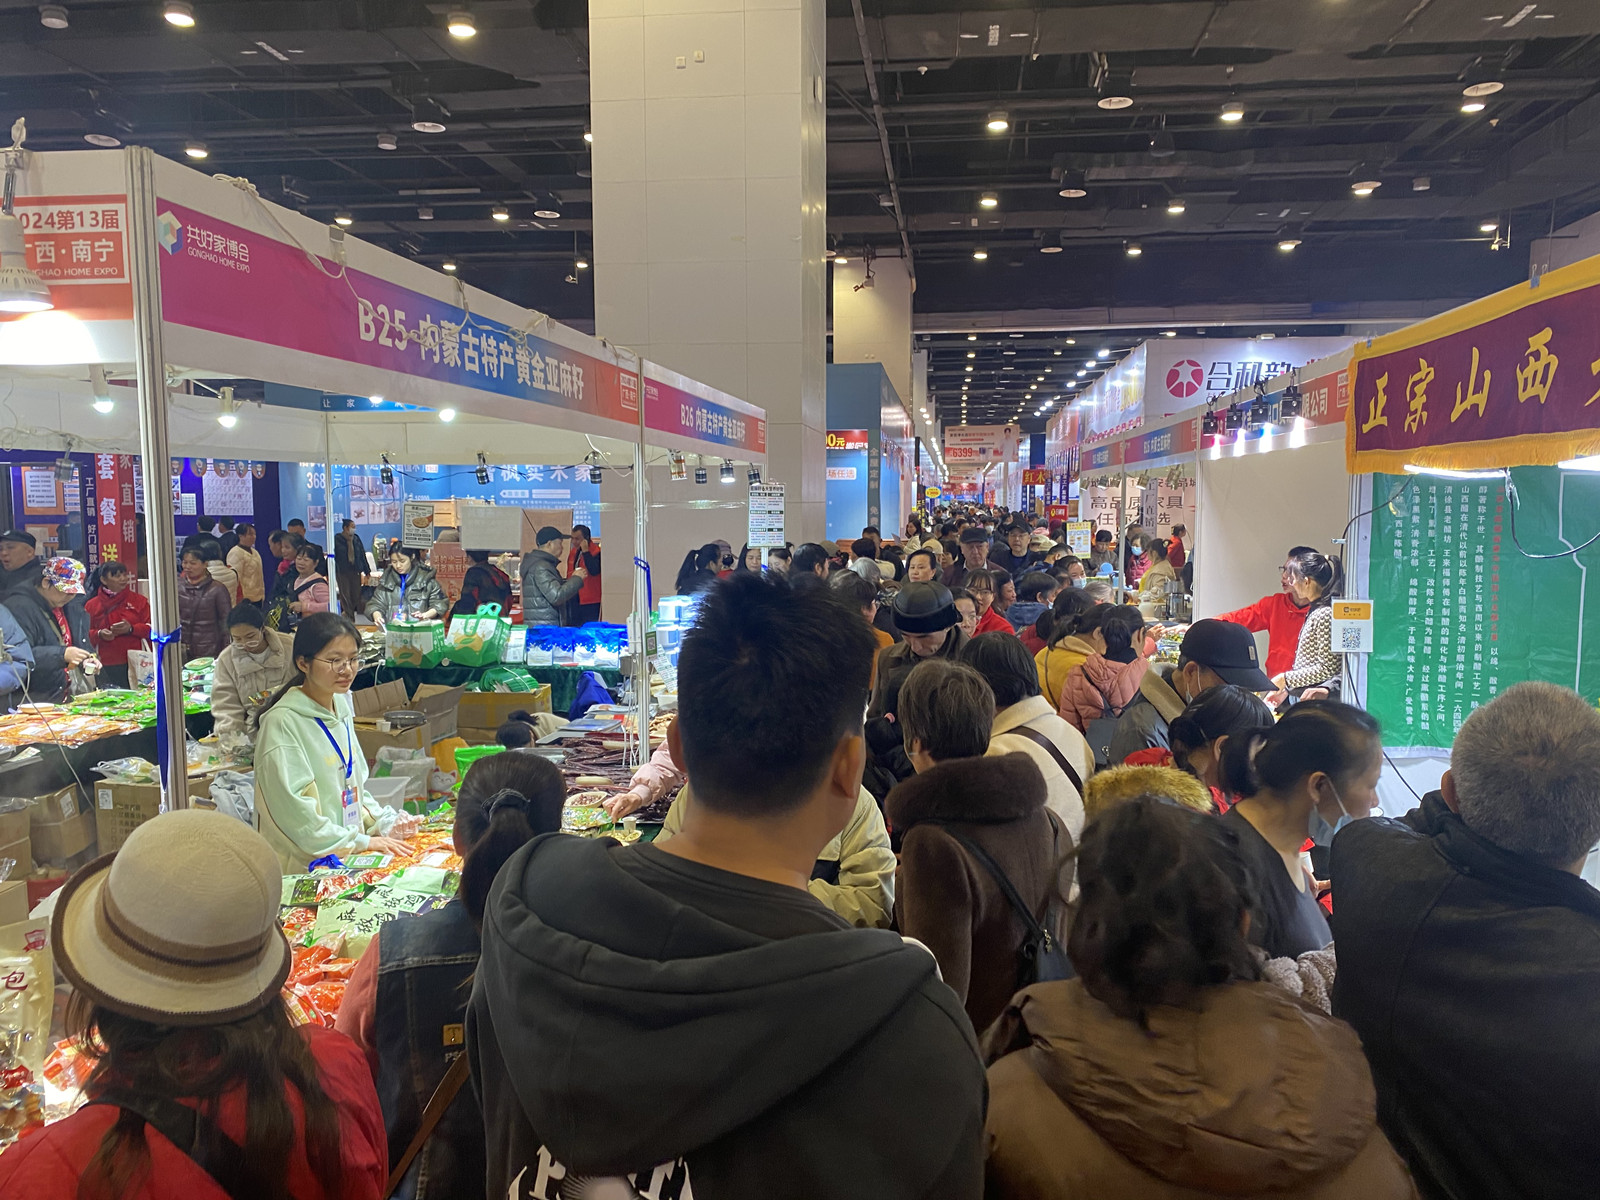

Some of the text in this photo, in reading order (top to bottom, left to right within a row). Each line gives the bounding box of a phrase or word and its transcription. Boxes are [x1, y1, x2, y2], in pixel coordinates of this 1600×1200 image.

[12, 209, 119, 230] 024第13届
[25, 238, 114, 264] 西·南宁
[186, 224, 249, 262] 共好家博会
[64, 268, 91, 276] HOME
[94, 267, 118, 275] EXPO
[187, 246, 250, 274] GONGHAO HOME EXPO
[1362, 326, 1600, 434] 正宗山西
[680, 403, 694, 428] B26
[952, 447, 973, 458] 6399
